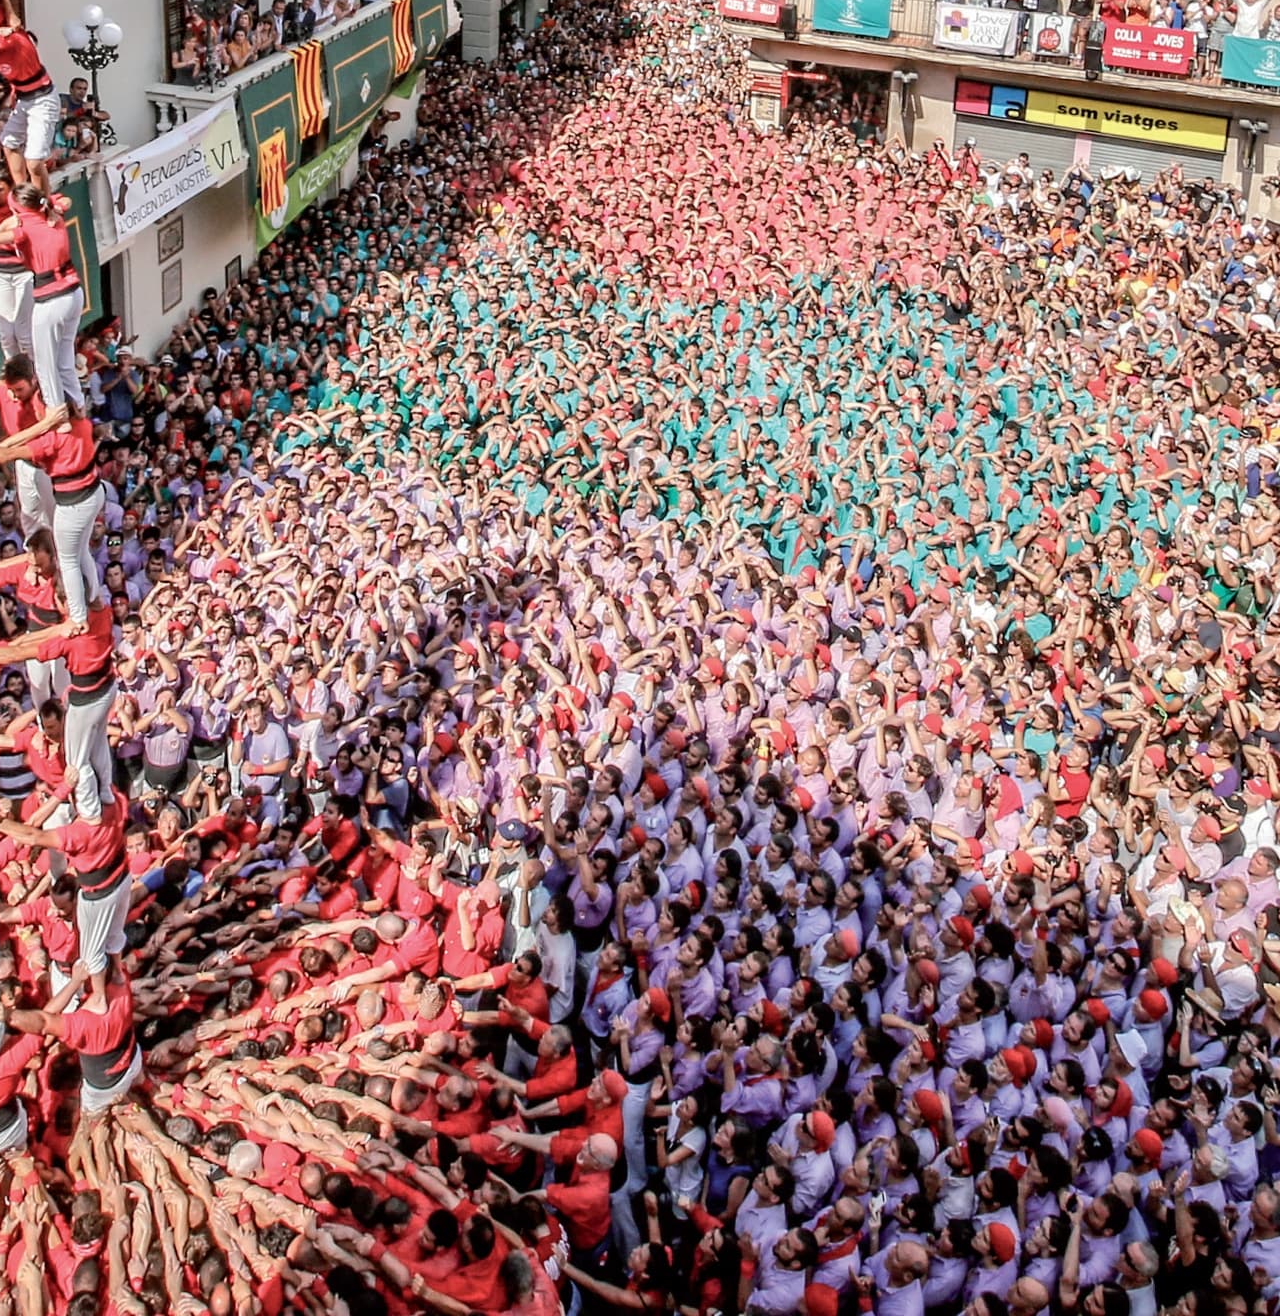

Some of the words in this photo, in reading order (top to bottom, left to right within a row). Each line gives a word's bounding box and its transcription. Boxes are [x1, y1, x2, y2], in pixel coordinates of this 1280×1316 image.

[1114, 28, 1143, 43] COLLA
[1153, 33, 1185, 50] JOVES
[1056, 104, 1099, 120] som
[1103, 110, 1179, 131] viatges
